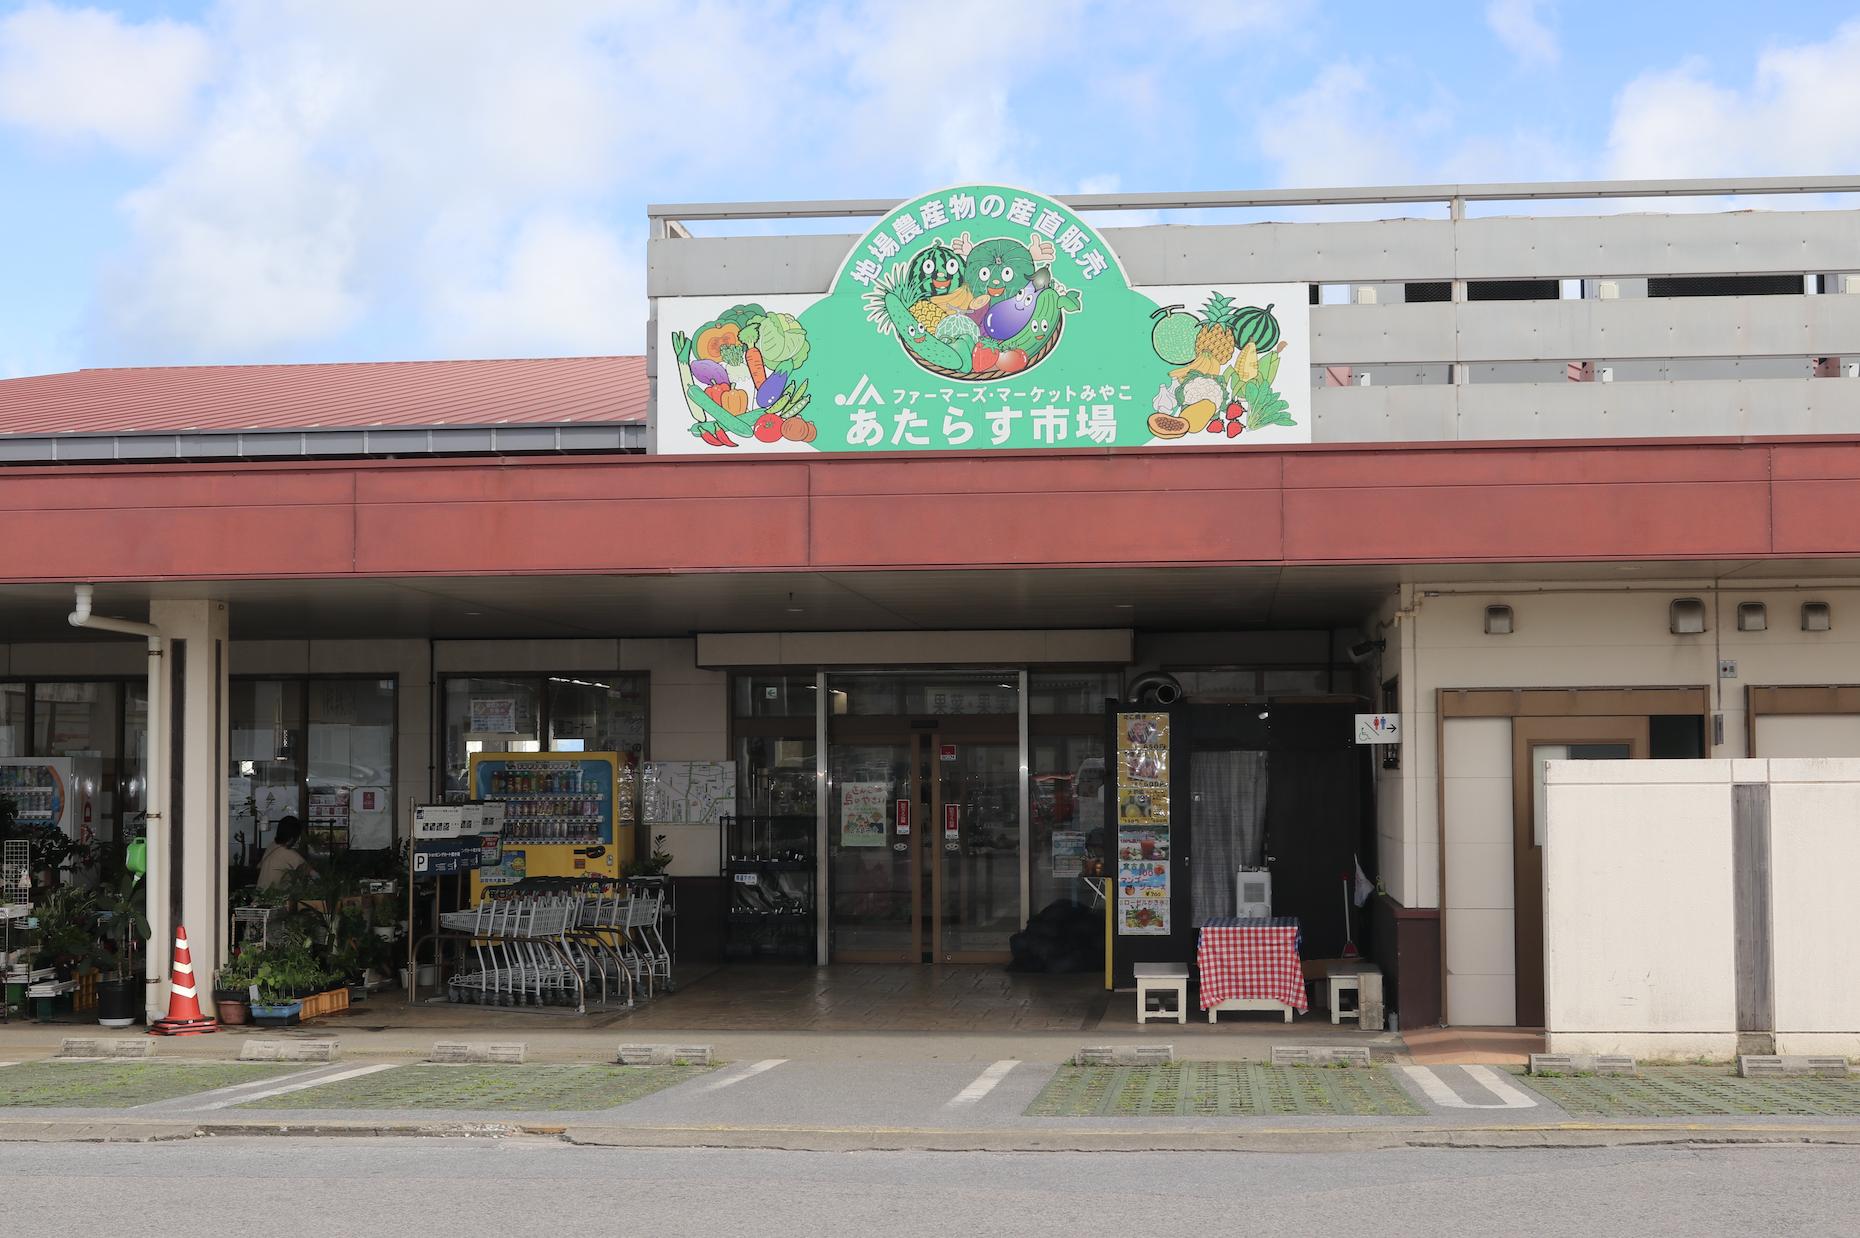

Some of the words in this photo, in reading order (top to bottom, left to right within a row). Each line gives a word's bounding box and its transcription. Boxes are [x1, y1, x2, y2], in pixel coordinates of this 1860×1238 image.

[850, 192, 1108, 287] 地場農産物の産直販売
[893, 384, 1133, 403] ファーマーズ・マーケットみやこ
[846, 404, 1117, 446] あたらす市場
[417, 855, 425, 869] P
